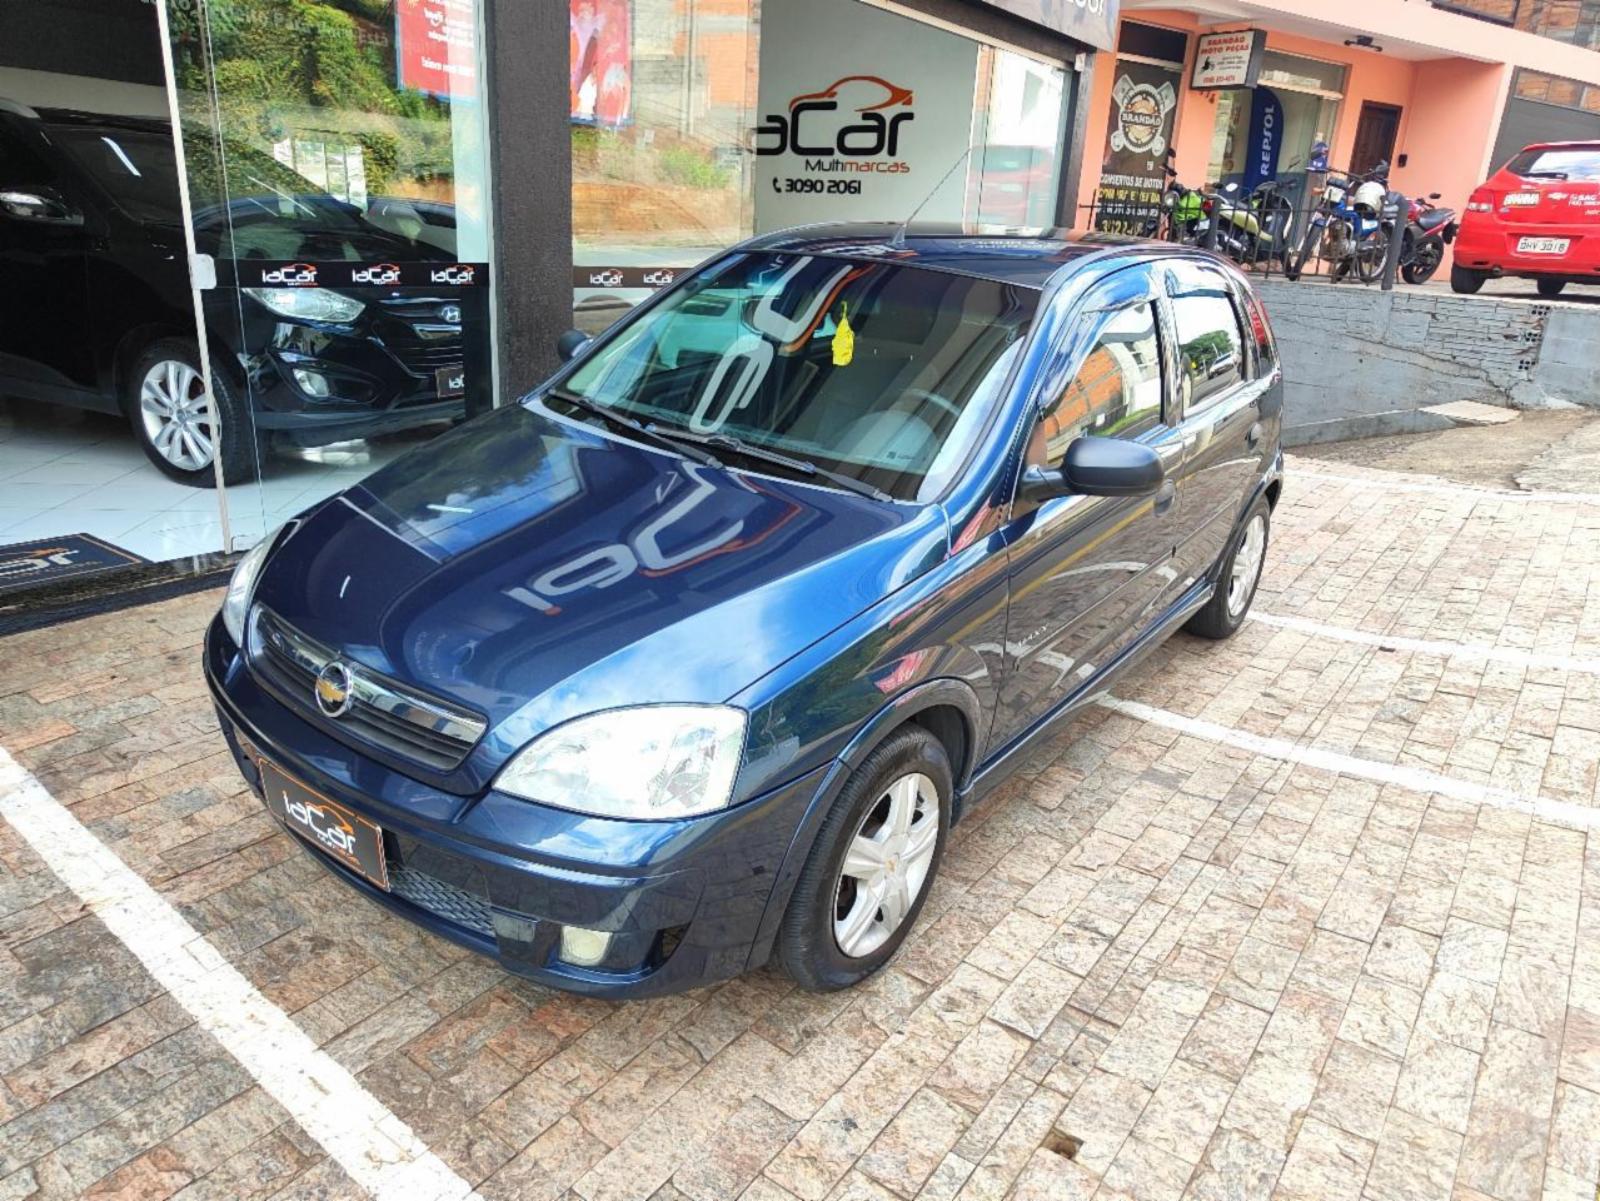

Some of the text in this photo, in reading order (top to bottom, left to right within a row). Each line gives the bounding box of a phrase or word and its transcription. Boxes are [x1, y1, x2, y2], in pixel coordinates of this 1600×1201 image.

[1260, 104, 1275, 176] REPSOL
[805, 158, 911, 173] Multimarcas
[785, 178, 862, 194] 3090 2061
